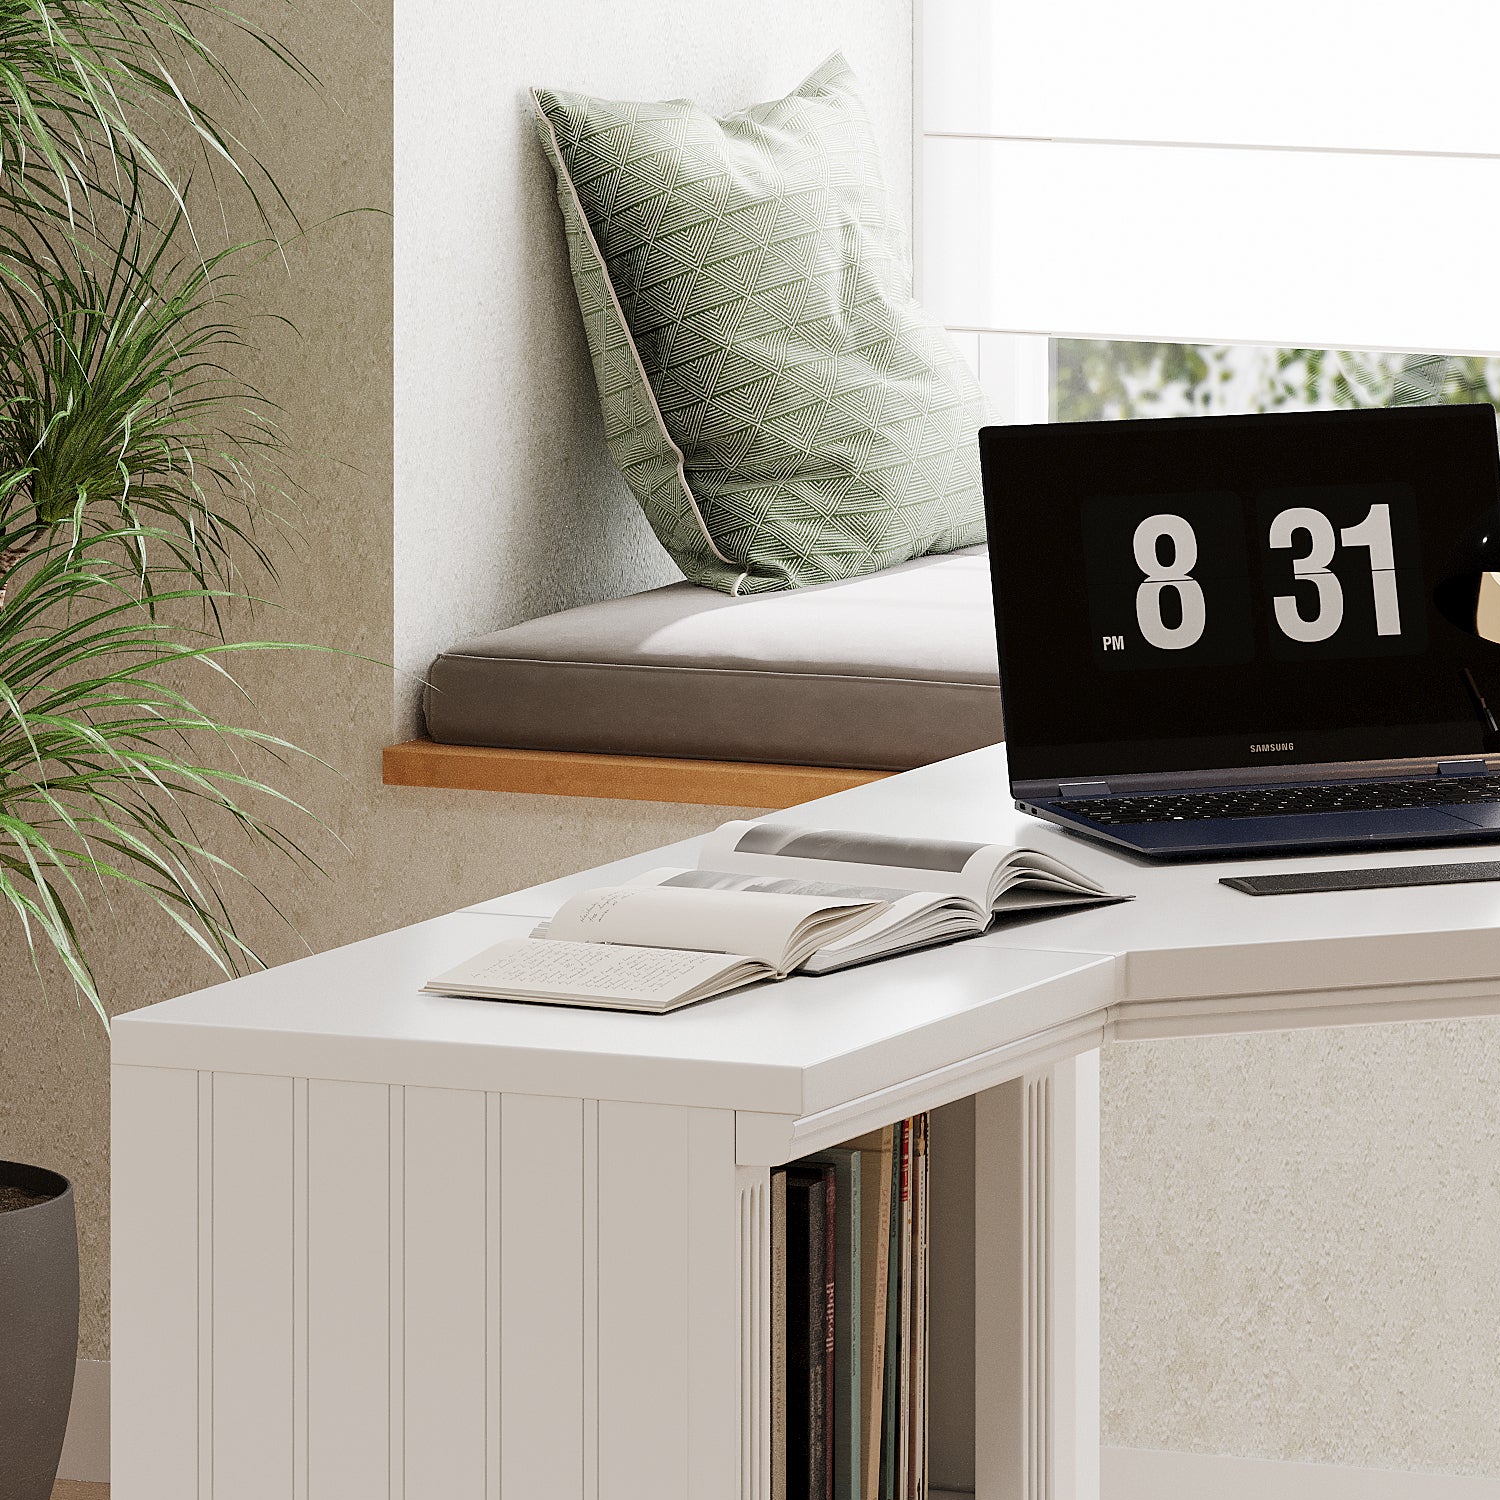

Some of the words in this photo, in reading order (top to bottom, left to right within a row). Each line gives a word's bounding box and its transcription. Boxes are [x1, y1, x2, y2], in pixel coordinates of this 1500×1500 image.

[1133, 513, 1206, 650] 8
[1269, 503, 1401, 642] 31
[1102, 635, 1125, 651] PM
[1250, 742, 1294, 753] SAMSUNG
